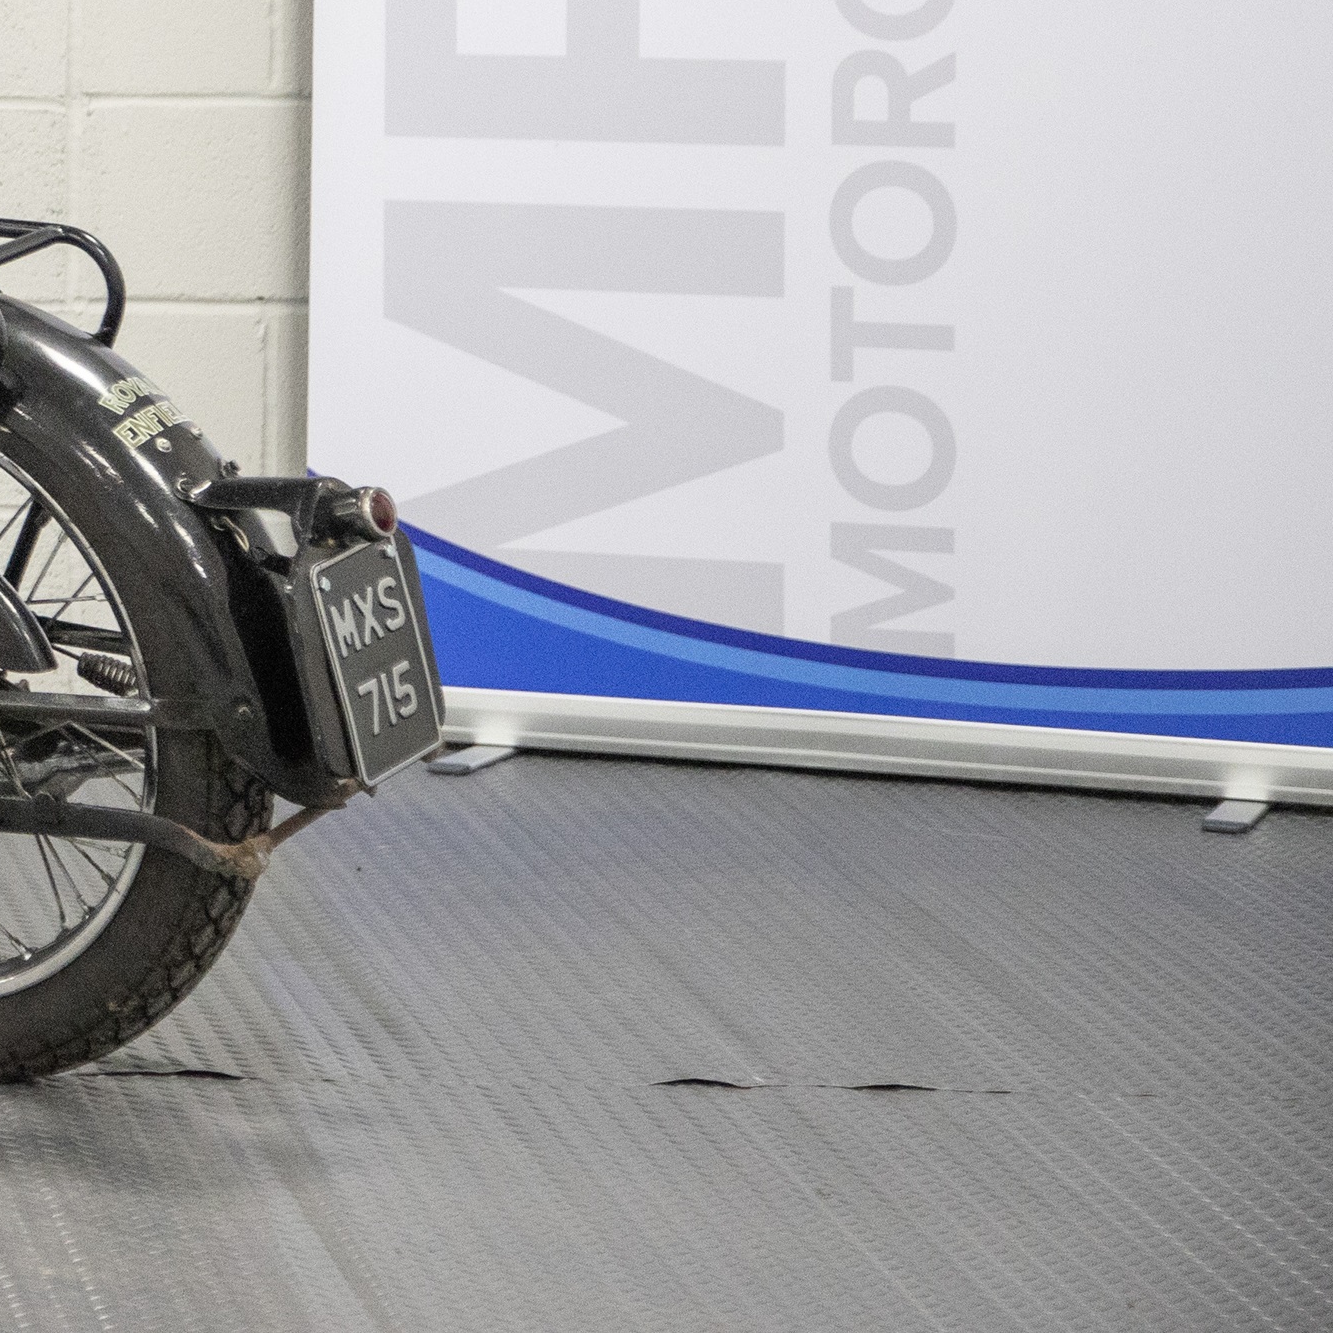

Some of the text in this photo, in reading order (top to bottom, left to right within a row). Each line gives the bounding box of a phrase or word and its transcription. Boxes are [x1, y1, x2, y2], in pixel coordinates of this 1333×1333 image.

[97, 376, 166, 416] ROYA
[330, 576, 406, 658] MXS
[358, 660, 417, 736] 715
